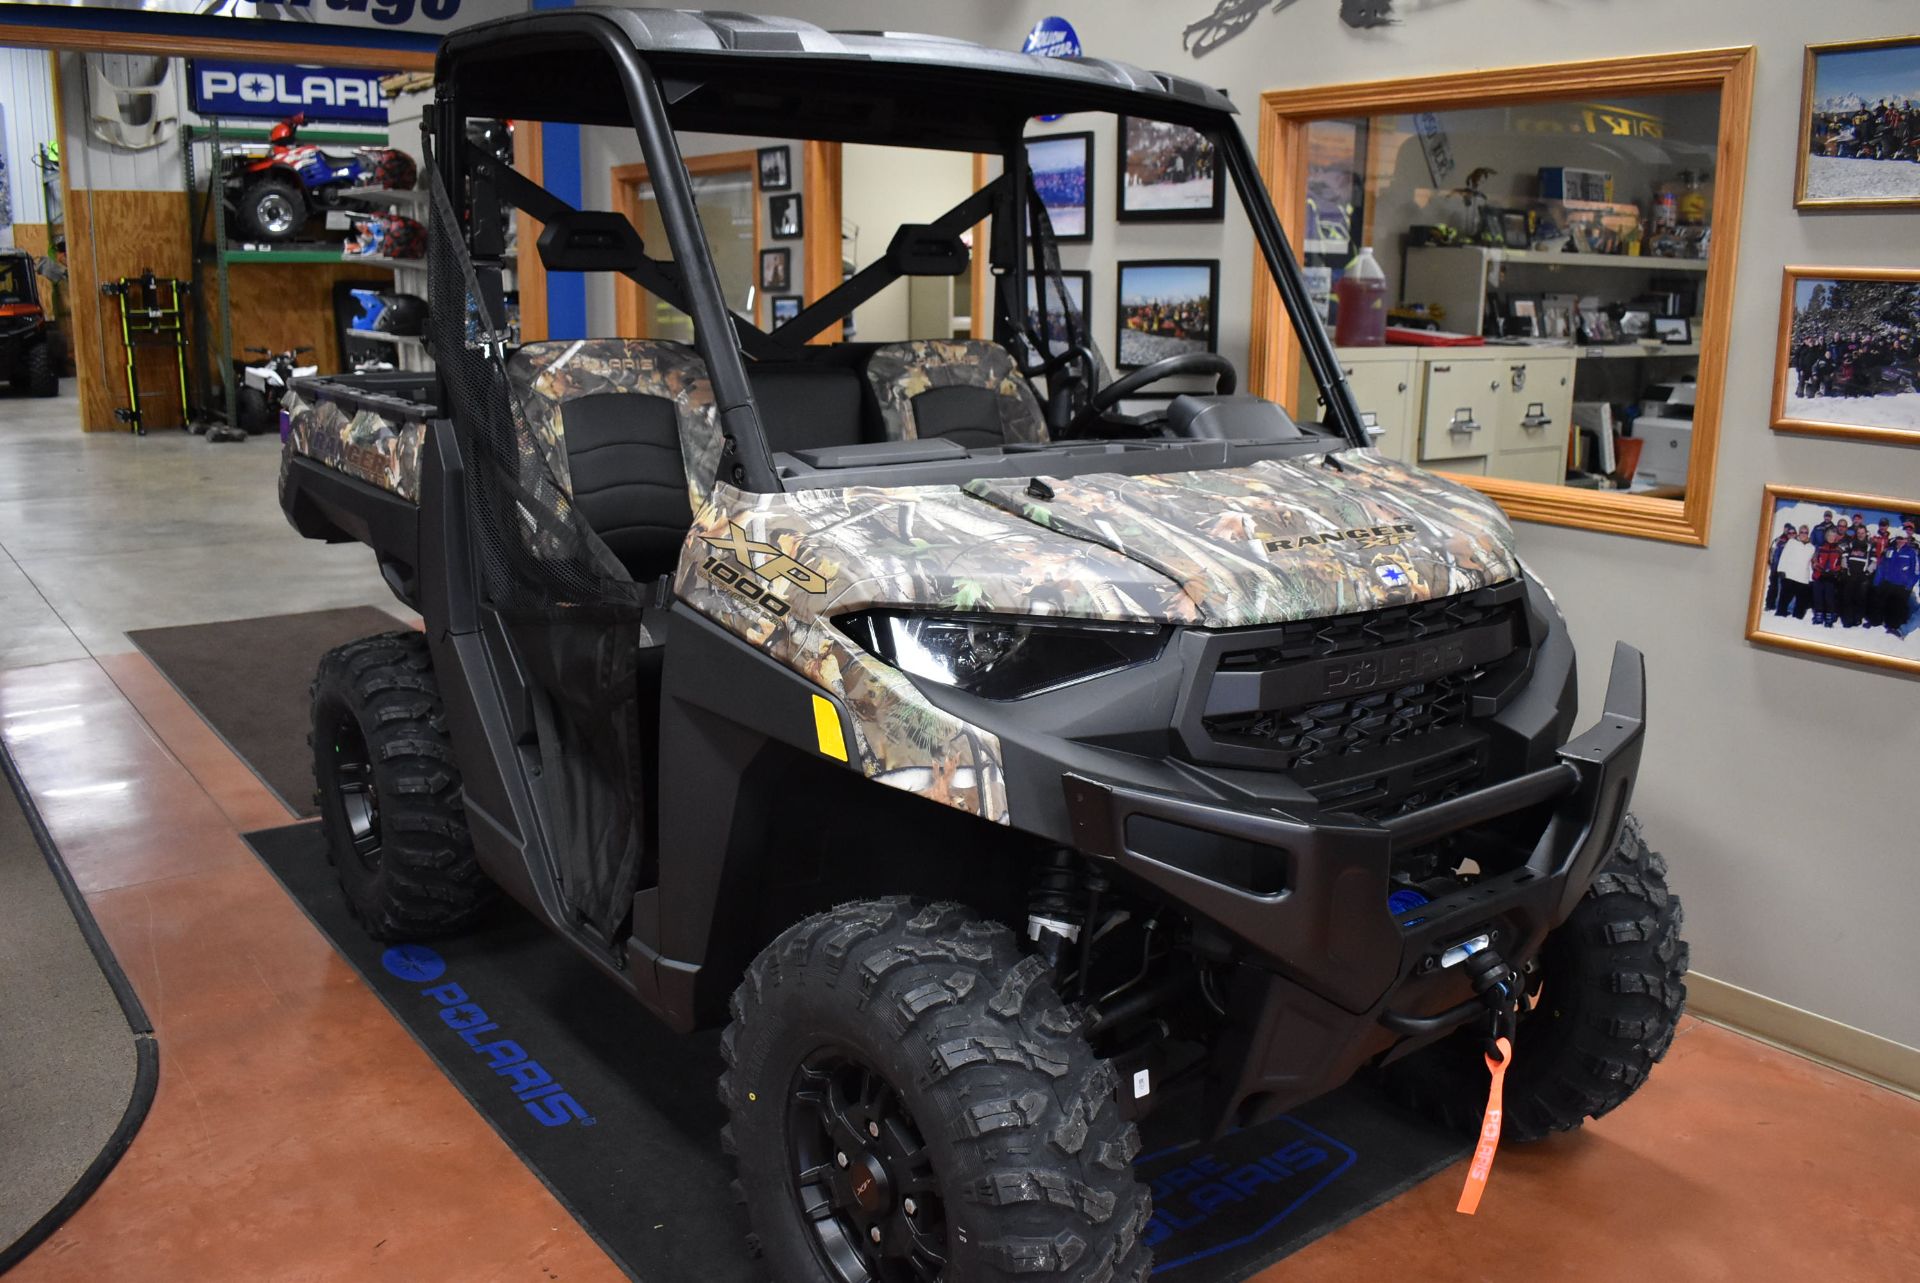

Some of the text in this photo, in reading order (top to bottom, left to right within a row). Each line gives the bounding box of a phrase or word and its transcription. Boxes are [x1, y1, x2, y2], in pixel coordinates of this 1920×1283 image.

[698, 520, 828, 595] XP
[1265, 524, 1416, 553] RANGER
[1357, 533, 1416, 550] XP
[703, 556, 791, 617] 1000
[1323, 645, 1464, 695] POLARIS
[421, 982, 592, 1127] POLARIS
[1471, 1109, 1501, 1182] POLARIS
[1143, 1139, 1329, 1247] OLARIS
